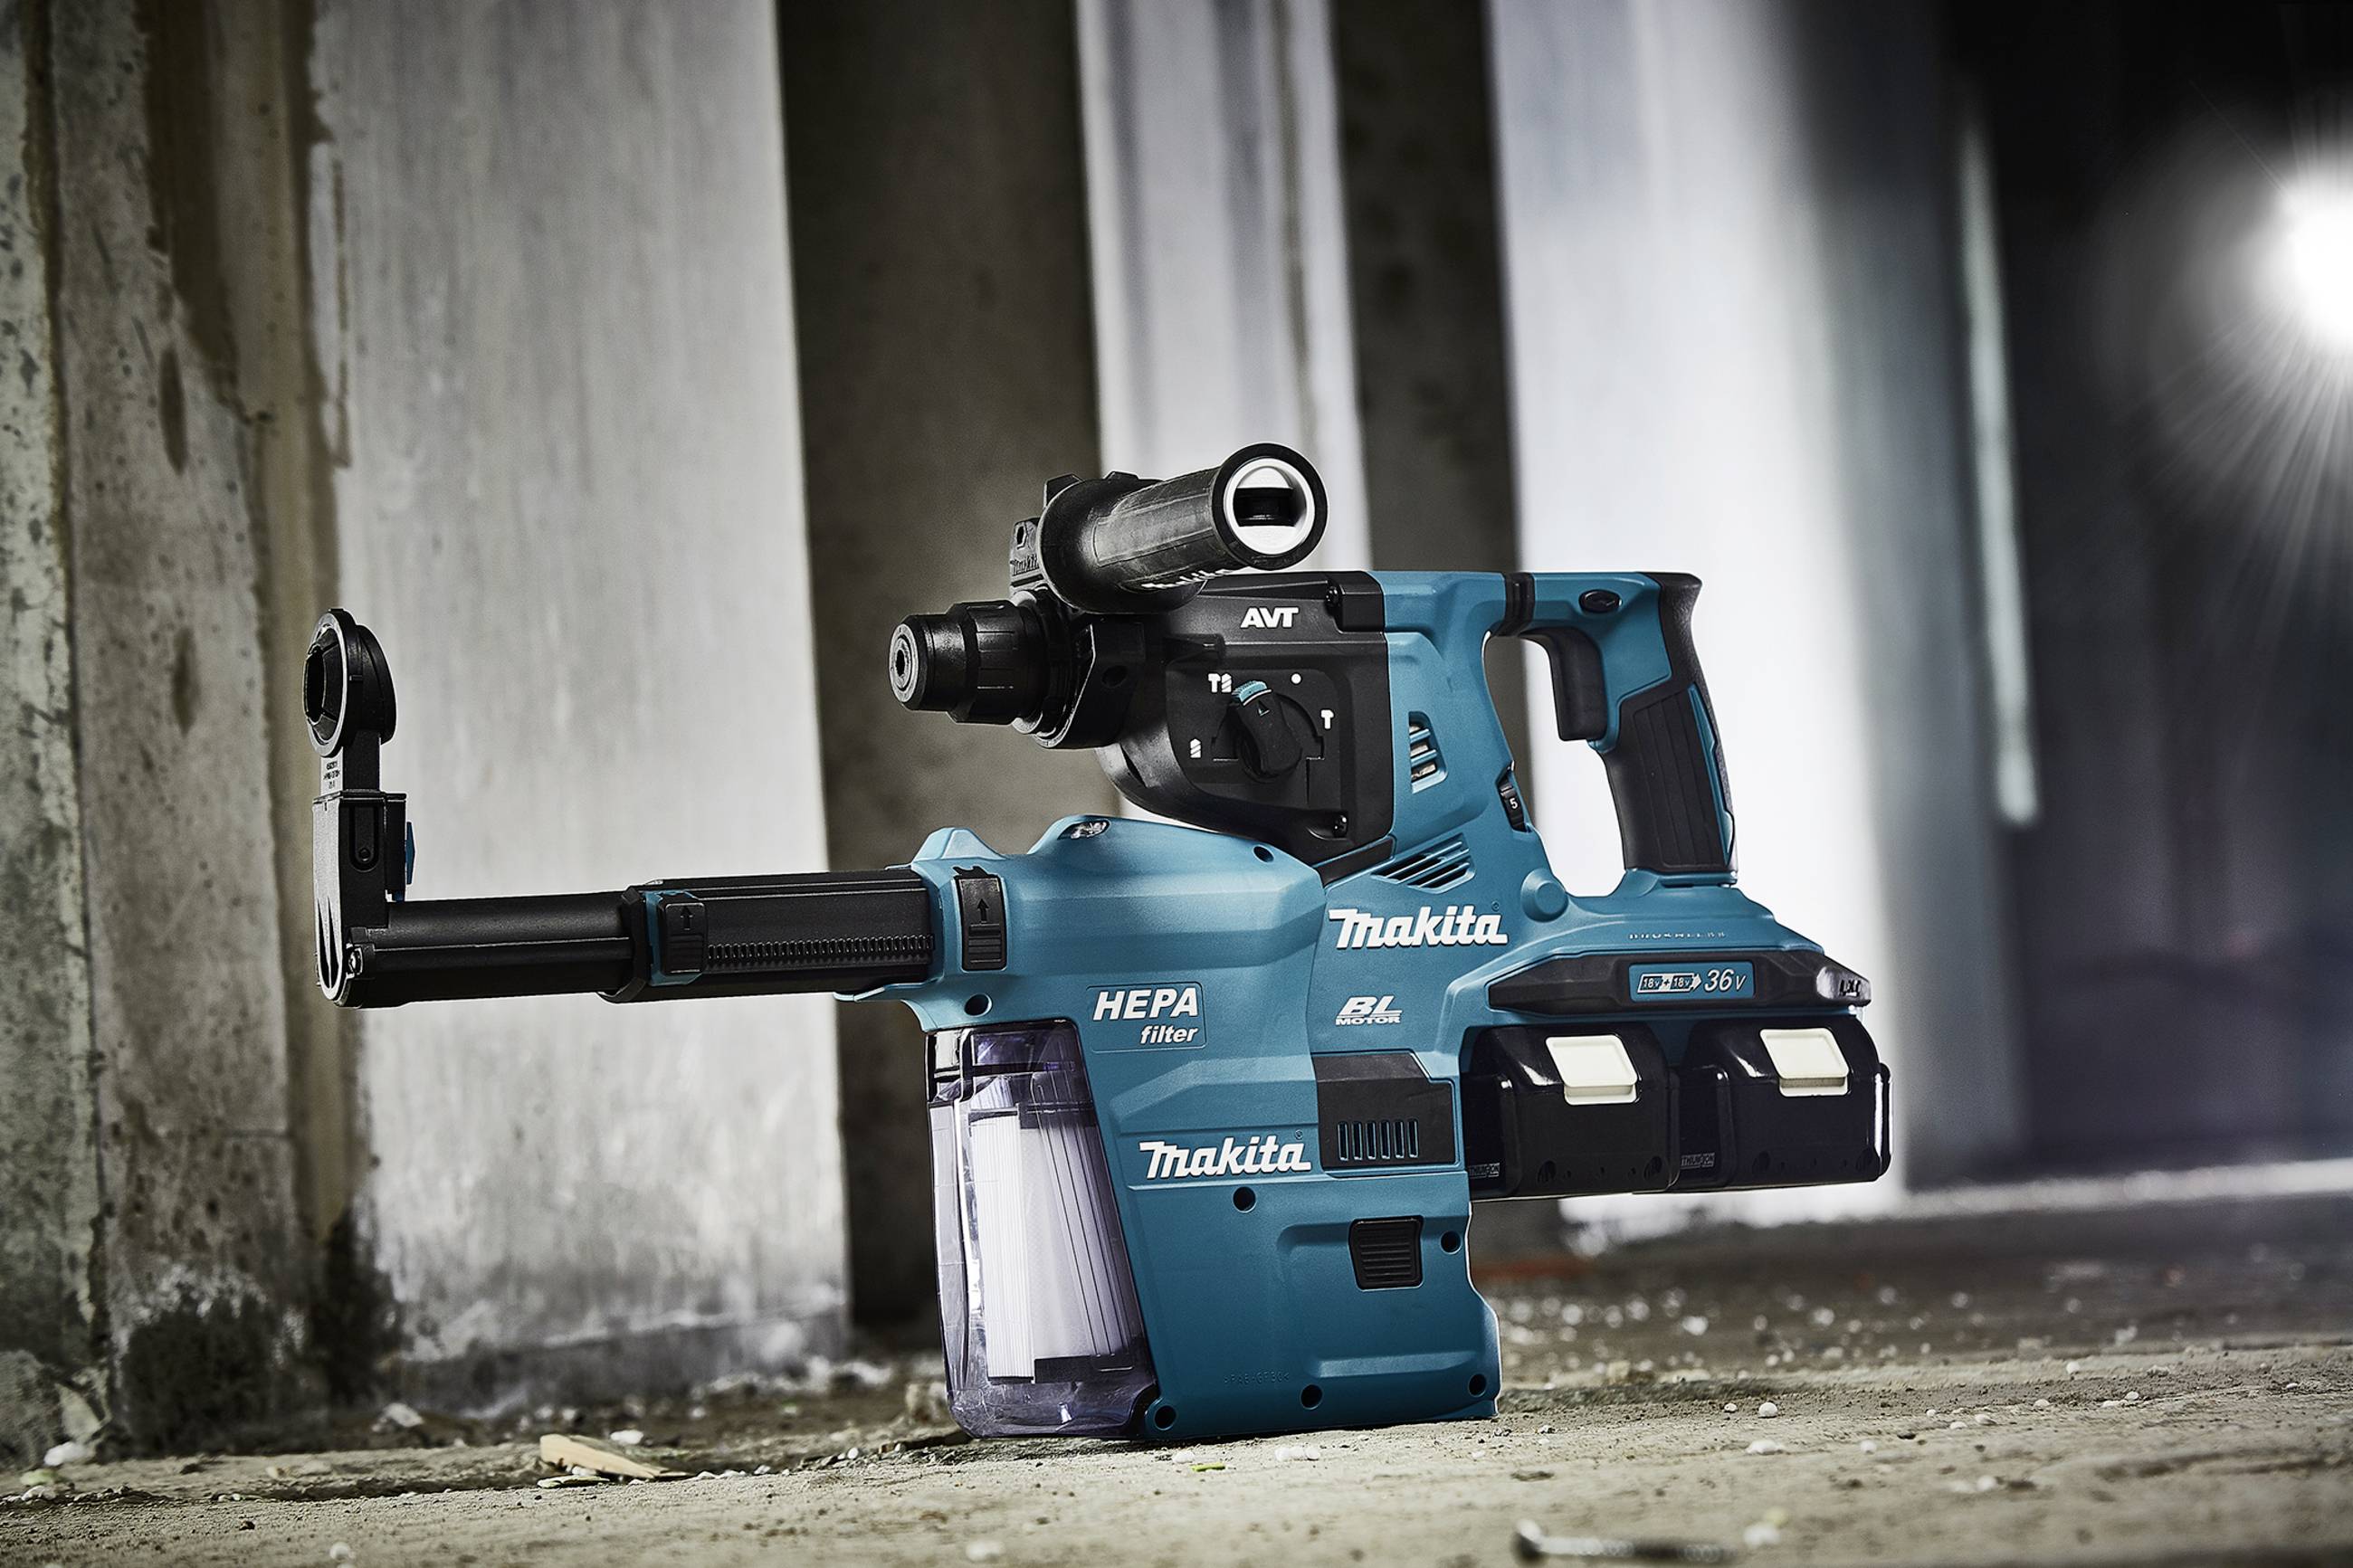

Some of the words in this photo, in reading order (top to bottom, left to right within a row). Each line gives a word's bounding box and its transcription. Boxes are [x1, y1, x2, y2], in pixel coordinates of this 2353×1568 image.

[1240, 607, 1300, 628] AVT
[1509, 797, 1519, 810] 5
[1328, 905, 1509, 949] Makita
[1092, 987, 1198, 1022] HEPA
[1338, 995, 1403, 1016] BL
[1335, 1016, 1401, 1026] MOTOR
[1140, 1025, 1198, 1045] filter
[1138, 1135, 1311, 1180] Makita
